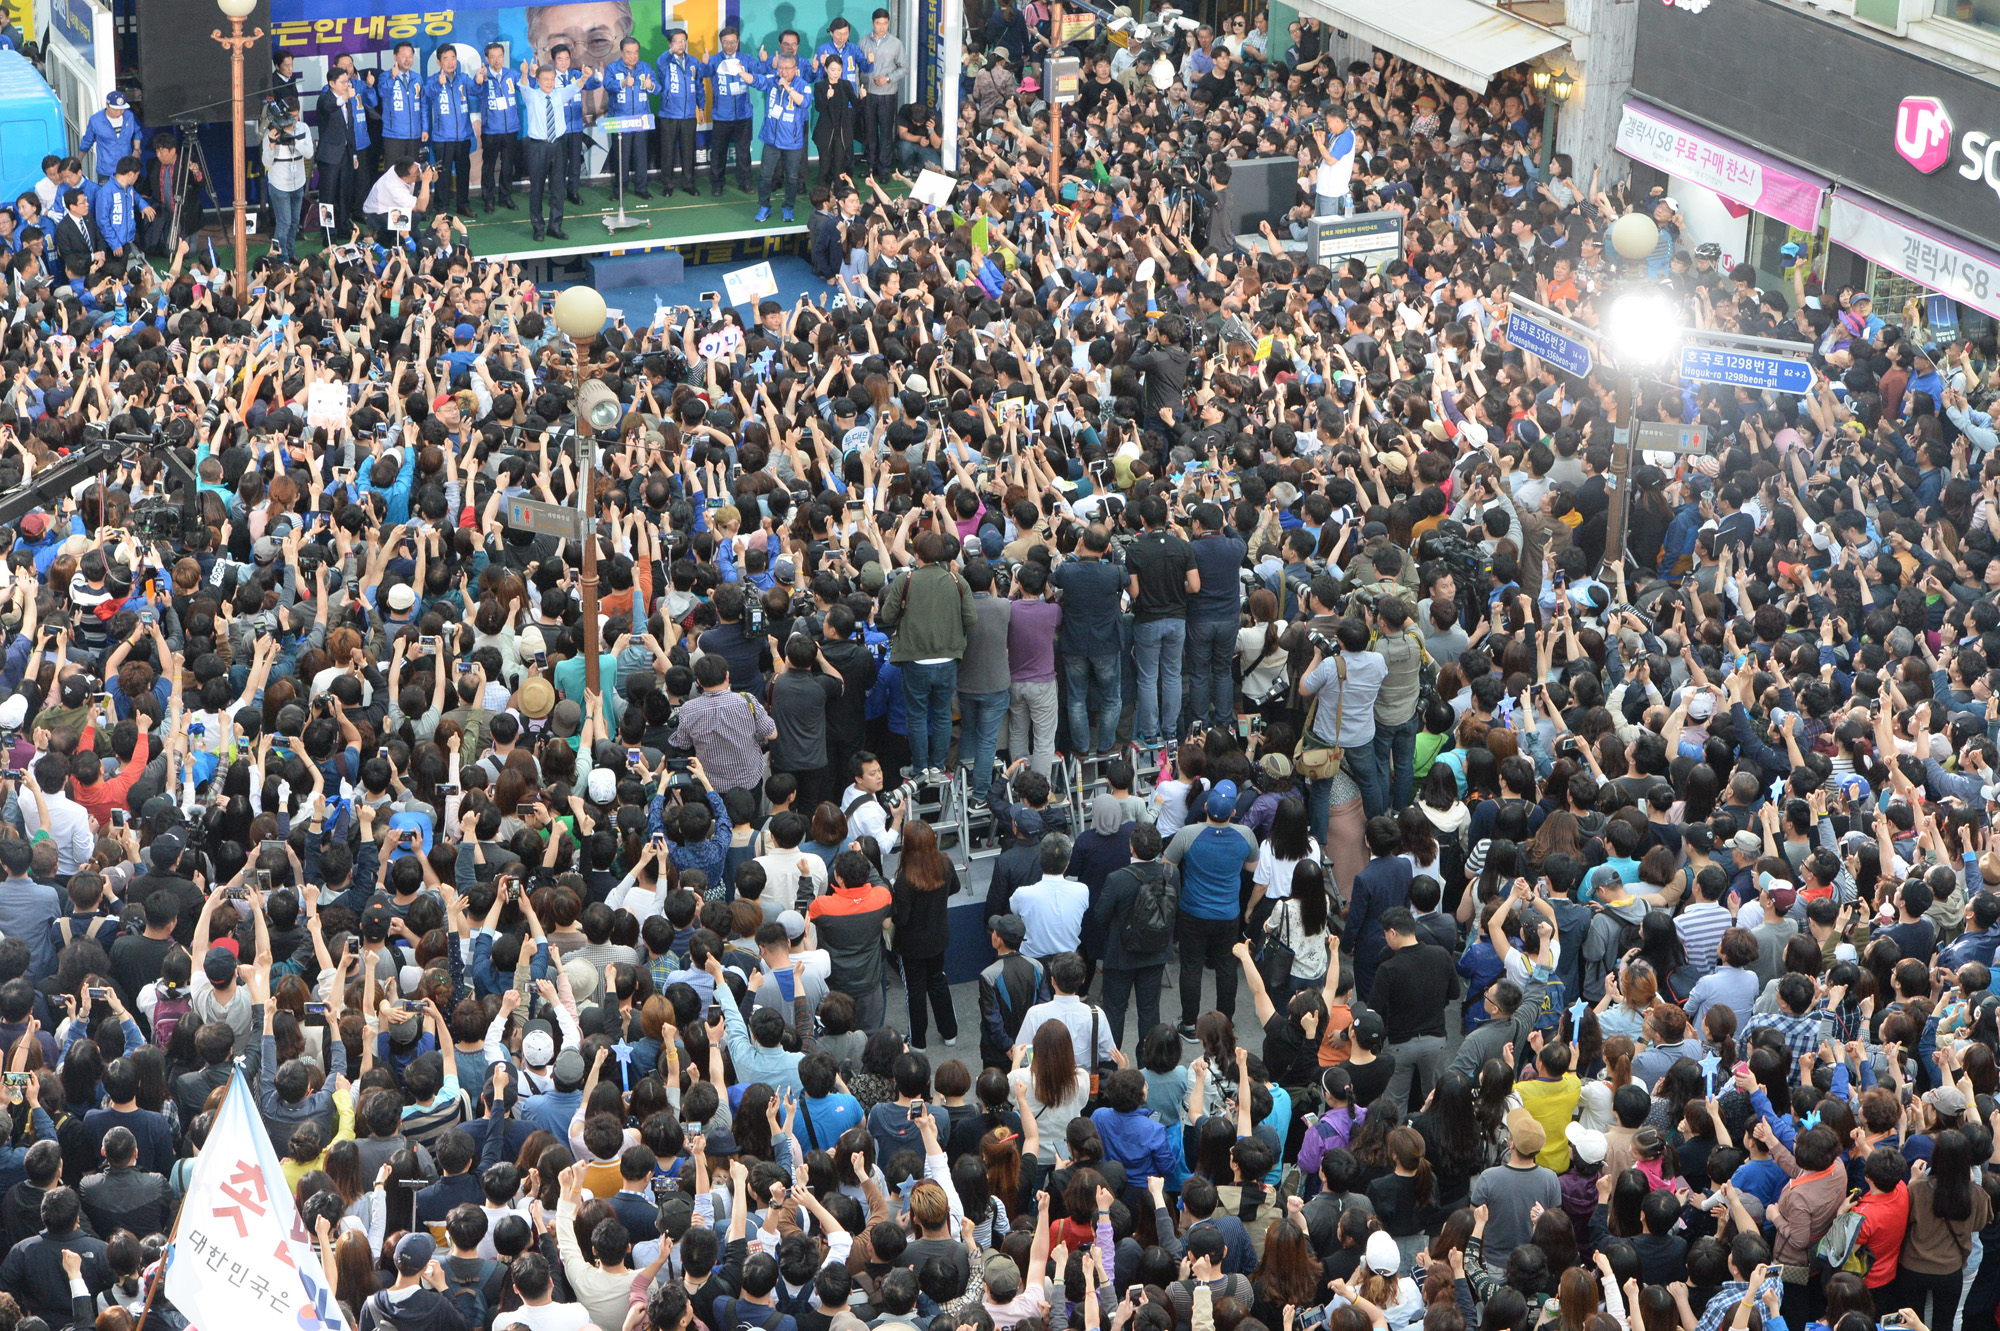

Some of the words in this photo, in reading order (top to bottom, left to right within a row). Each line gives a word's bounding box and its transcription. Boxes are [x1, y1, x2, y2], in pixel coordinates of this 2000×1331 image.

[847, 56, 855, 71] 1
[506, 78, 515, 94] 1
[1625, 116, 1657, 146] 갤럭시
[1656, 131, 1674, 152] S8
[1674, 136, 1697, 162] 무료
[1701, 148, 1724, 176] 구매
[1726, 158, 1755, 186] 찬스!
[113, 193, 122, 225] 문재인
[44, 234, 55, 250] 1
[1902, 236, 1957, 287] 갤럭시
[1962, 264, 1989, 300] S8
[1509, 332, 1546, 356] Pyeonghwa-ro
[1546, 349, 1578, 371] 536beon-gil
[1511, 316, 1567, 355] 평화로536번길
[1684, 366, 1722, 380] Hoguk-ro
[1725, 372, 1778, 388] 1298beon-gil
[1686, 350, 1779, 377] 호국로1298번길
[188, 1229, 291, 1314] 대한민국은
